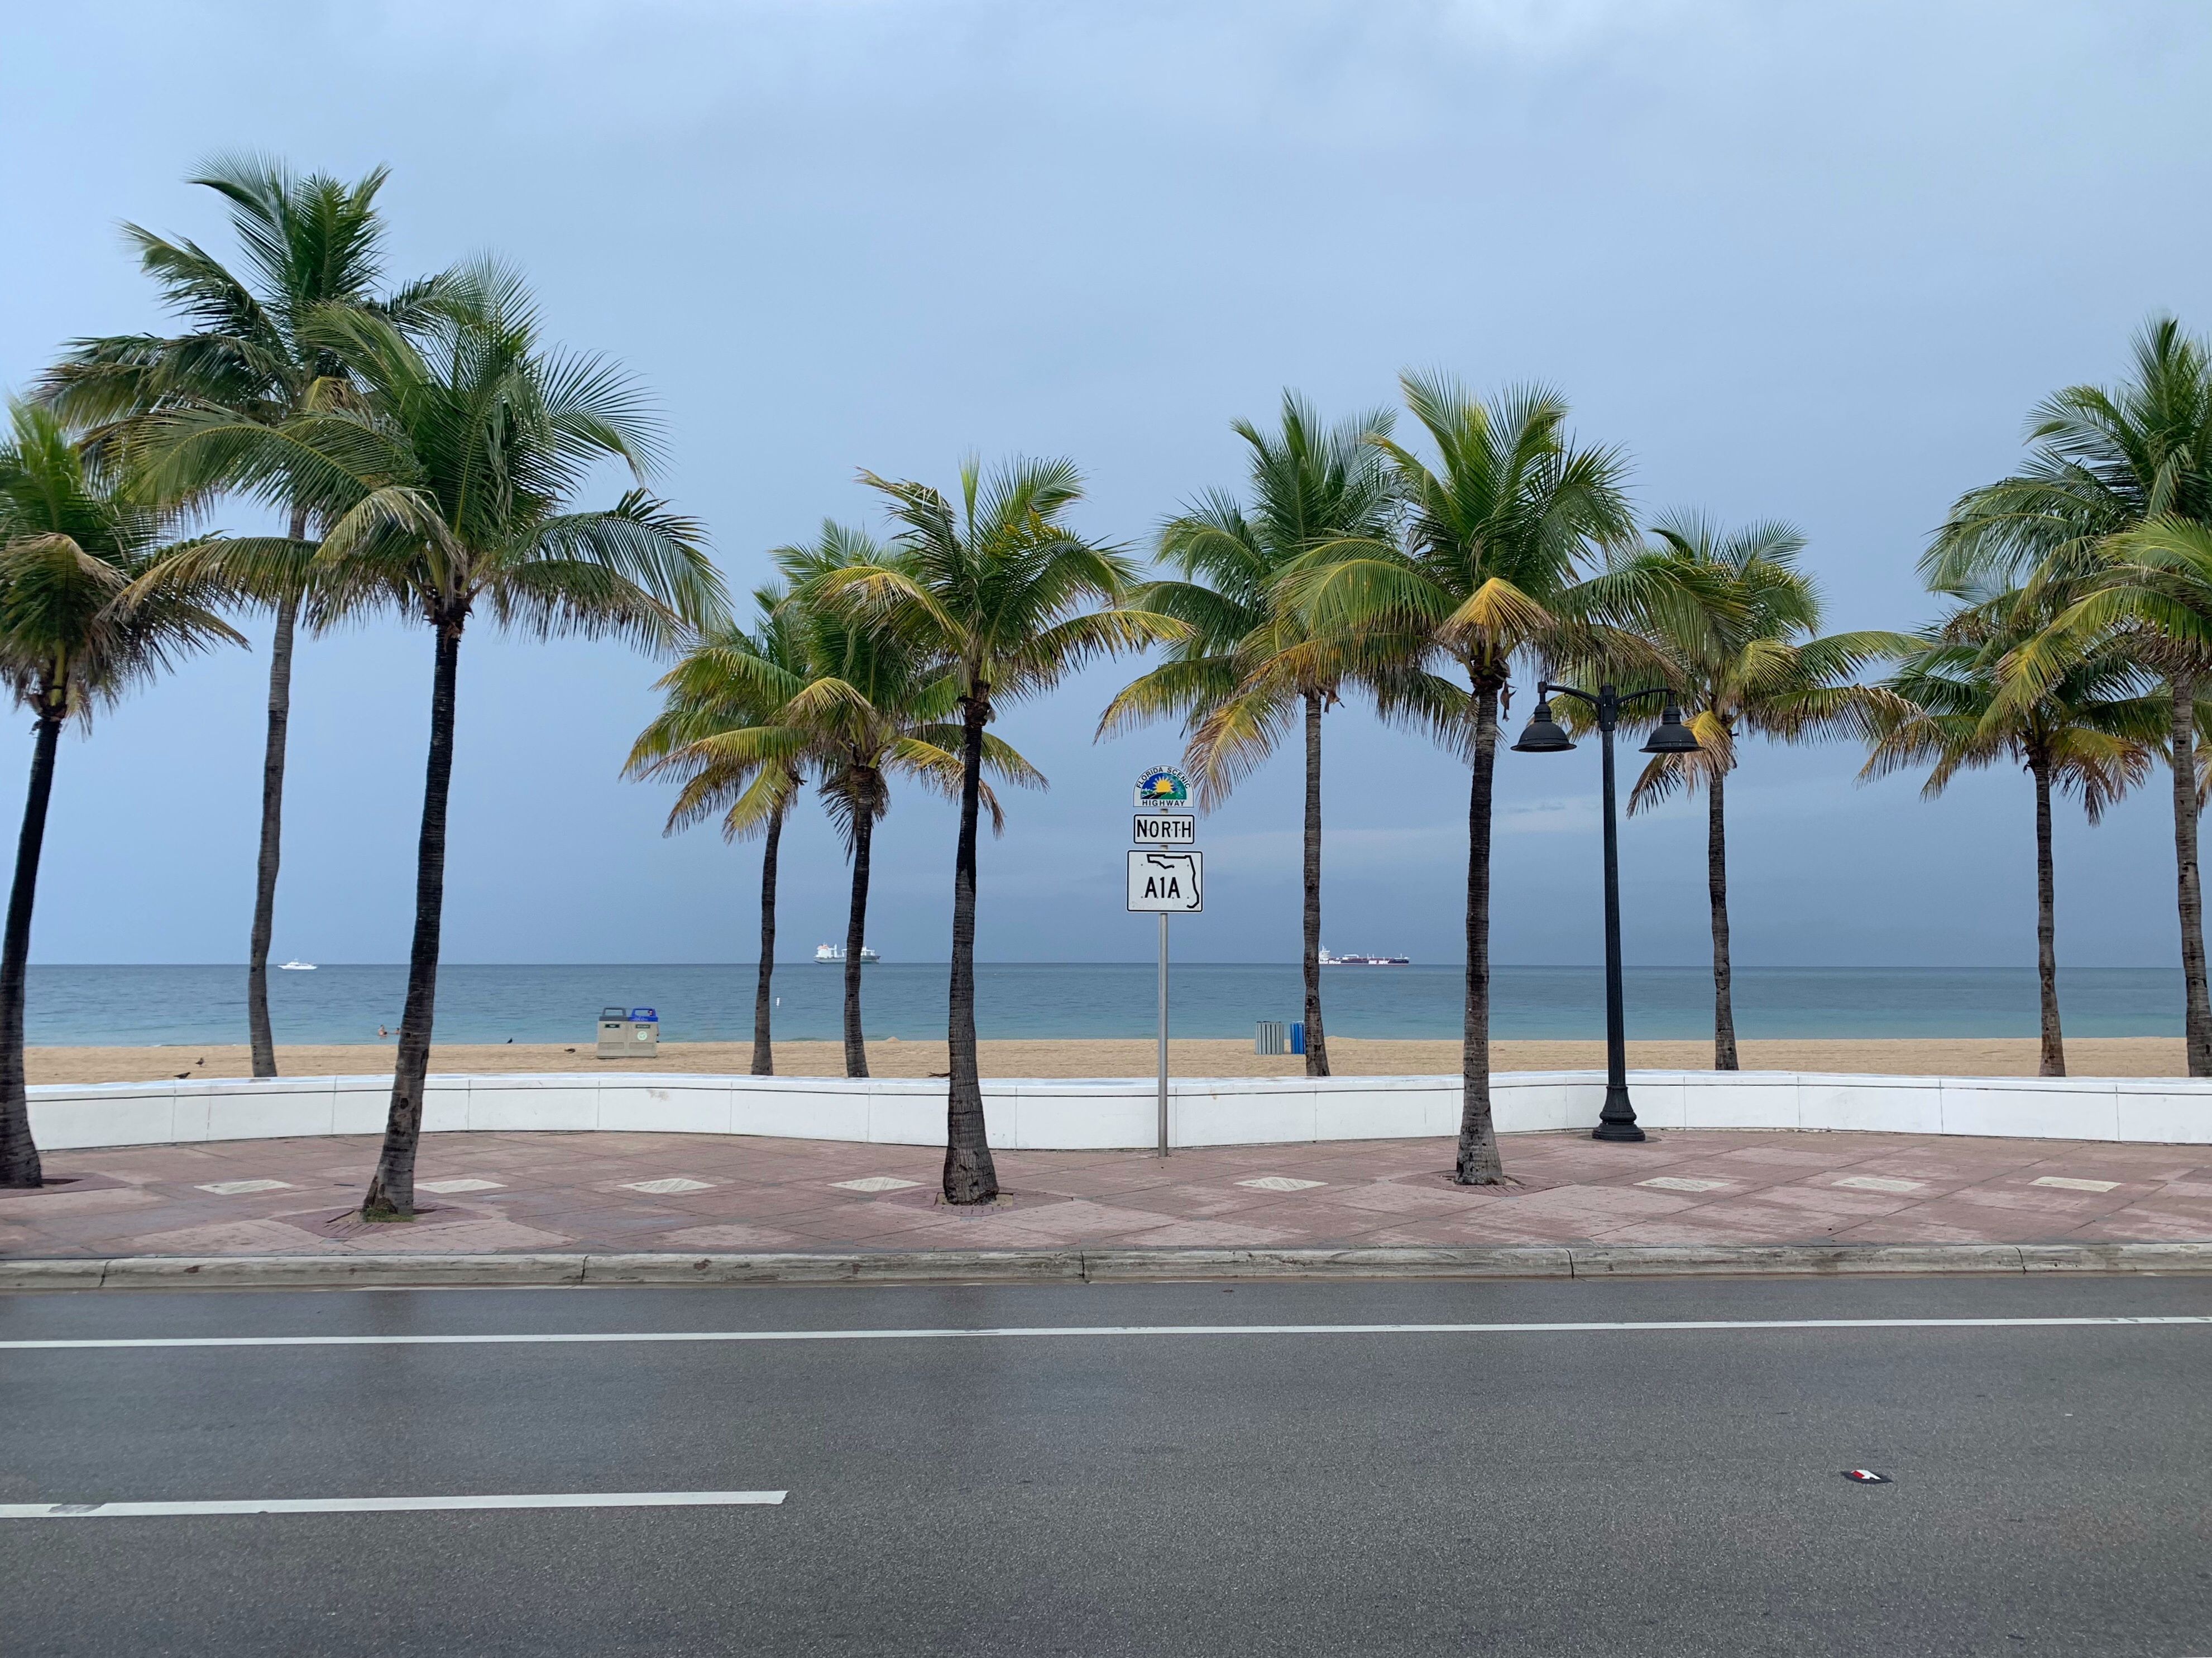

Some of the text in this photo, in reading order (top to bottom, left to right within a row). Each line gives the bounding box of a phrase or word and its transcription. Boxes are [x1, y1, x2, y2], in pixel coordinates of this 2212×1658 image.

[1136, 766, 1190, 789] FLORIDA SCENIC
[1137, 819, 1191, 837] NORTH
[1145, 876, 1180, 898] A1A
